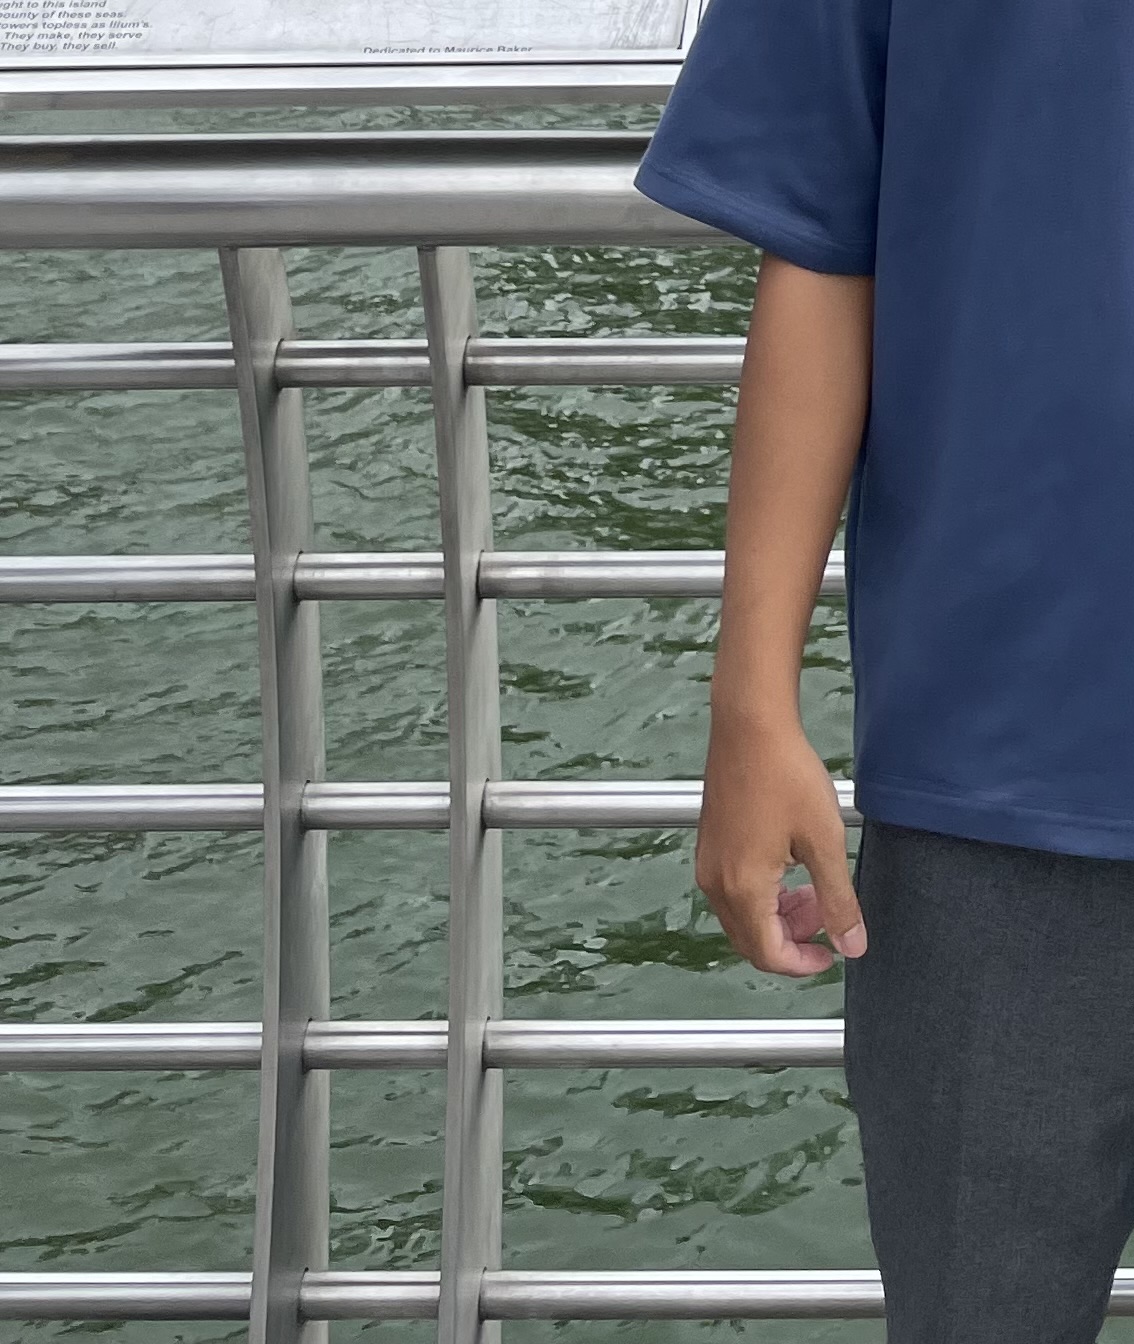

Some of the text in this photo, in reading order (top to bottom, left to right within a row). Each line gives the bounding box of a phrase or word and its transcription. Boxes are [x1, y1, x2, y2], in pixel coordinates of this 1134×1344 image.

[41, 21, 87, 30] topless
[4, 32, 34, 40] They
[77, 32, 105, 40] they
[0, 42, 90, 51] They they
